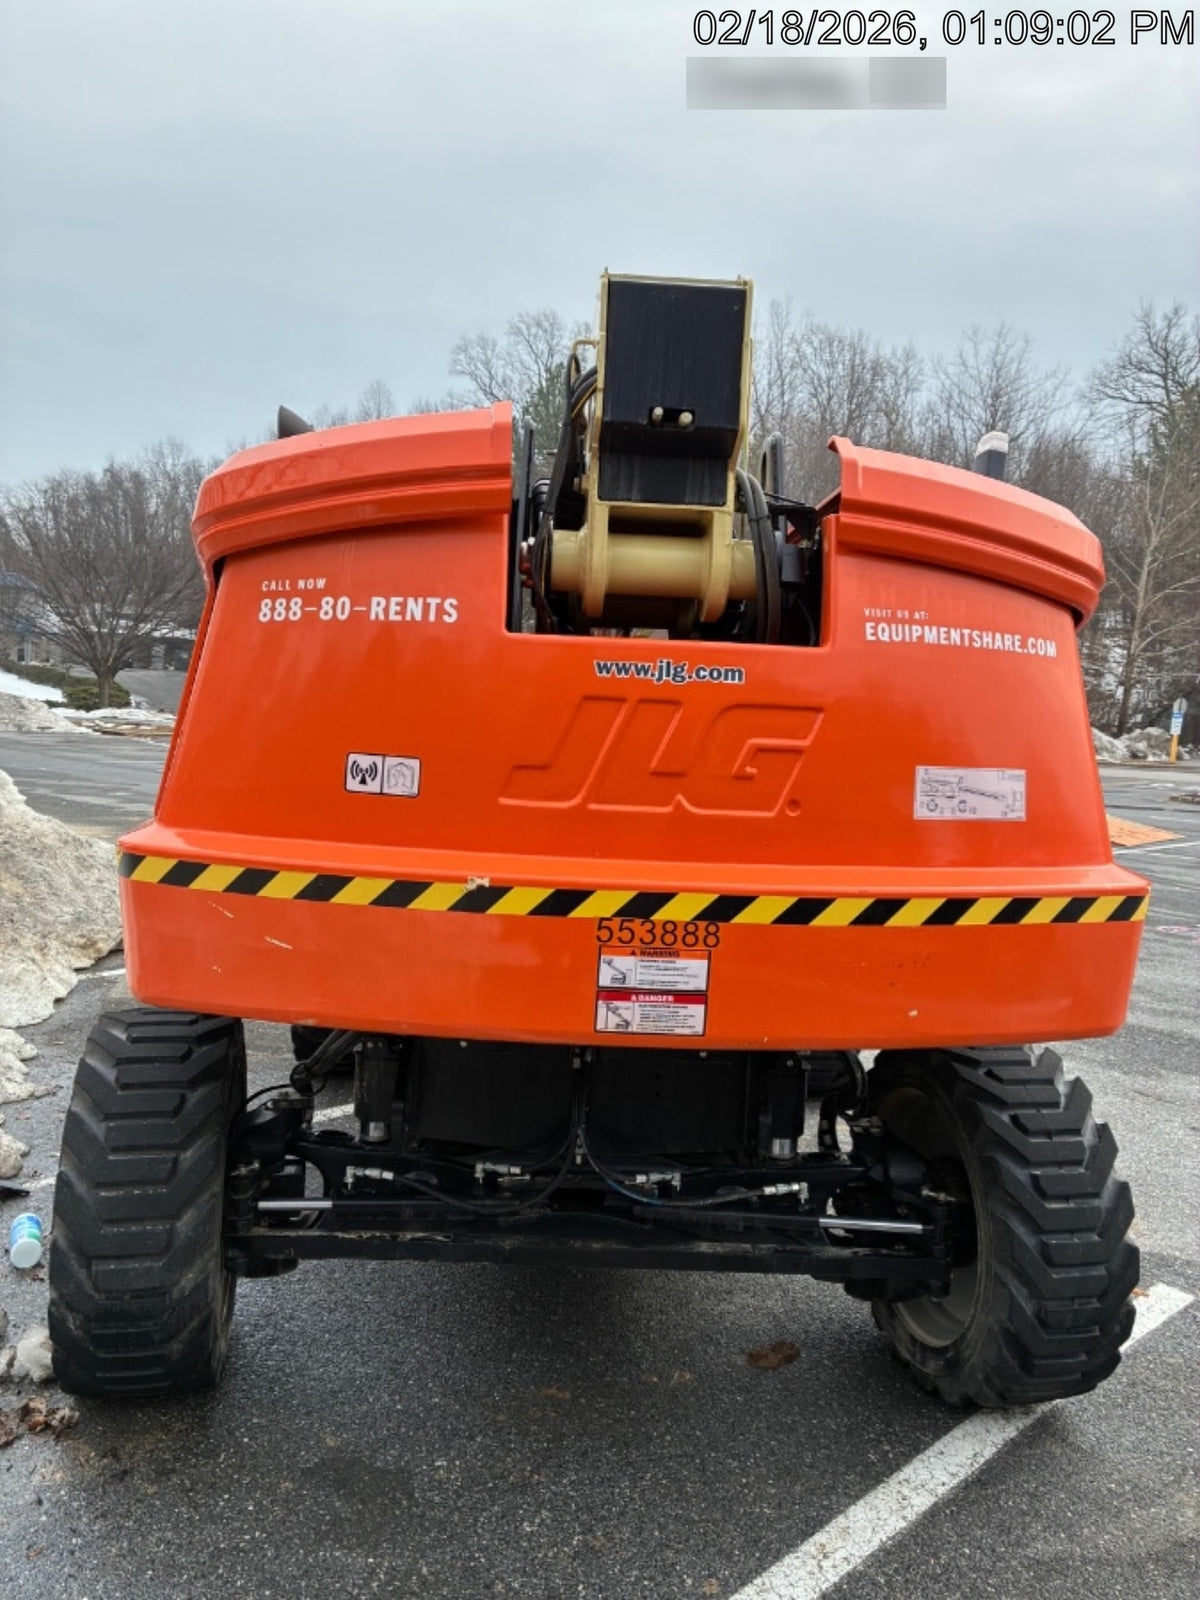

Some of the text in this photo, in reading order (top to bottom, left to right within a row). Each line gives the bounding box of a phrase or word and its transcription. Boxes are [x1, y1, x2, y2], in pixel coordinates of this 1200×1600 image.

[262, 577, 327, 591] CALL NOW
[258, 596, 459, 623] 888-80-RENTS
[864, 608, 929, 620] VISIT US AT:
[865, 621, 1057, 658] EQUIPMENTSHARE.COM
[594, 658, 744, 684] www.jlg.com
[498, 695, 824, 817] JLG
[596, 917, 720, 948] 553888
